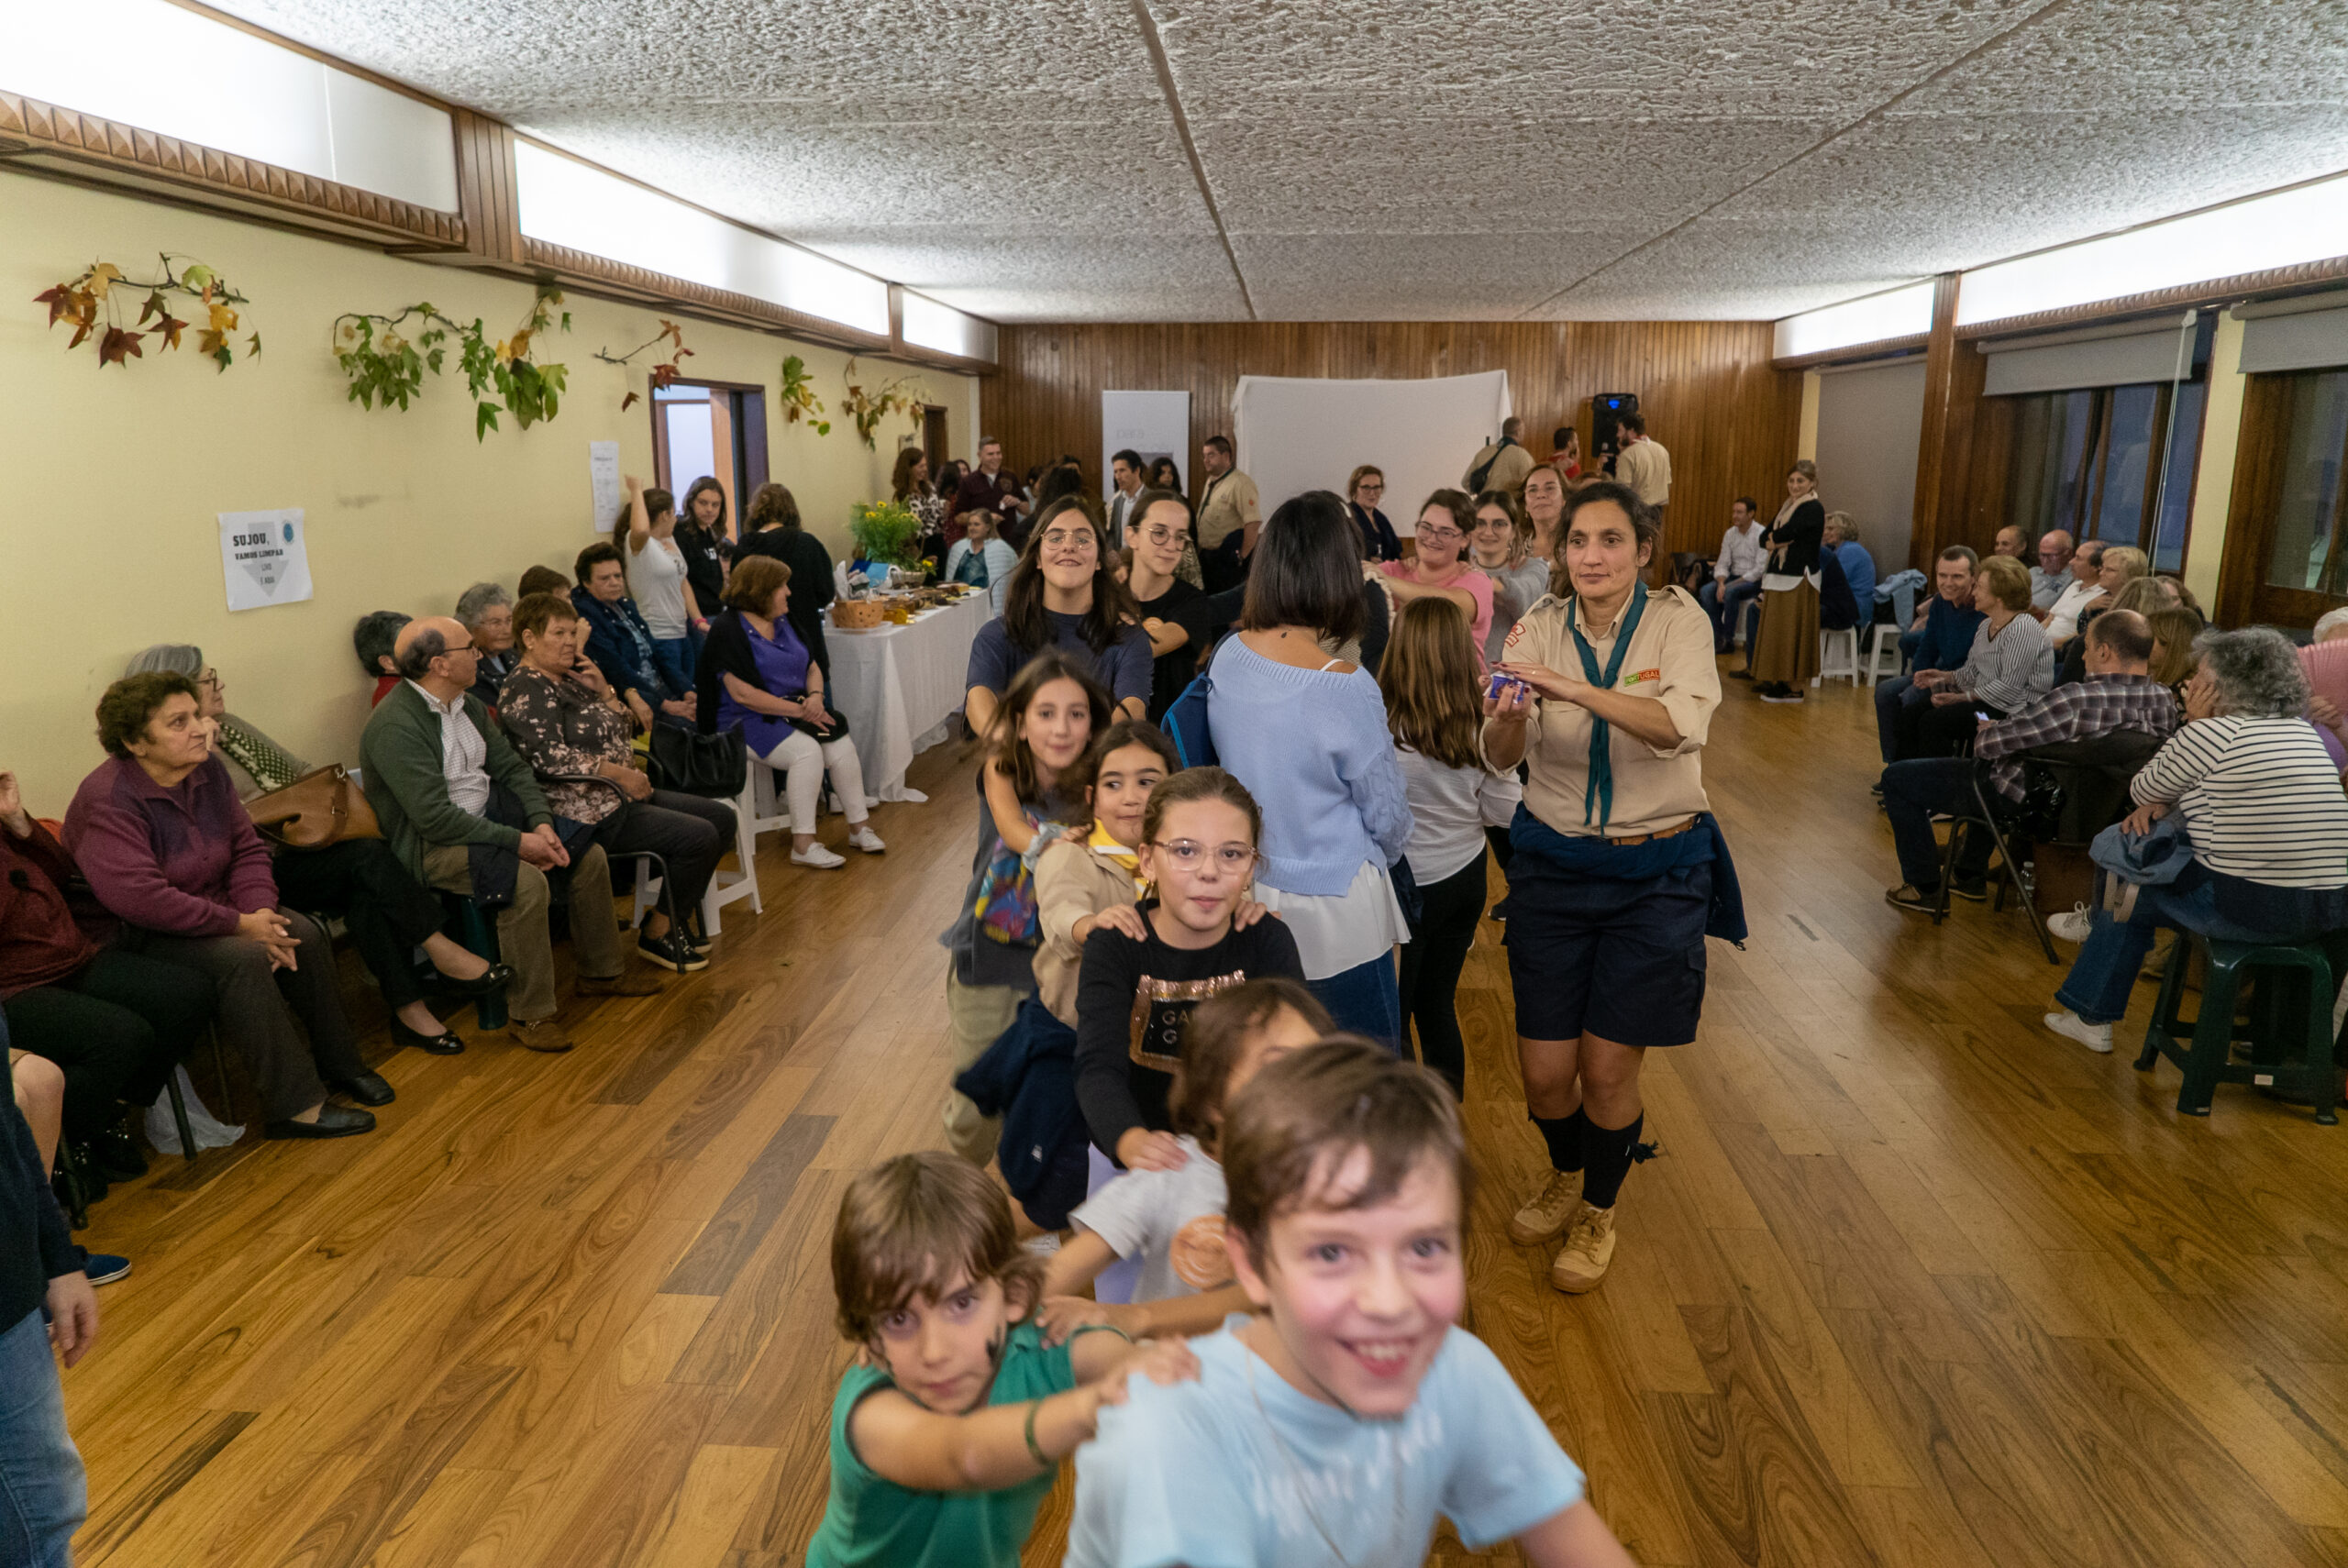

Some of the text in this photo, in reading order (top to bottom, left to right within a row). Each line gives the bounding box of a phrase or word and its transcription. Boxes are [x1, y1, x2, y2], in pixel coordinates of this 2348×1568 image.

[233, 533, 270, 547] SUJOU,
[235, 548, 283, 560] VAMOS LIMPAR
